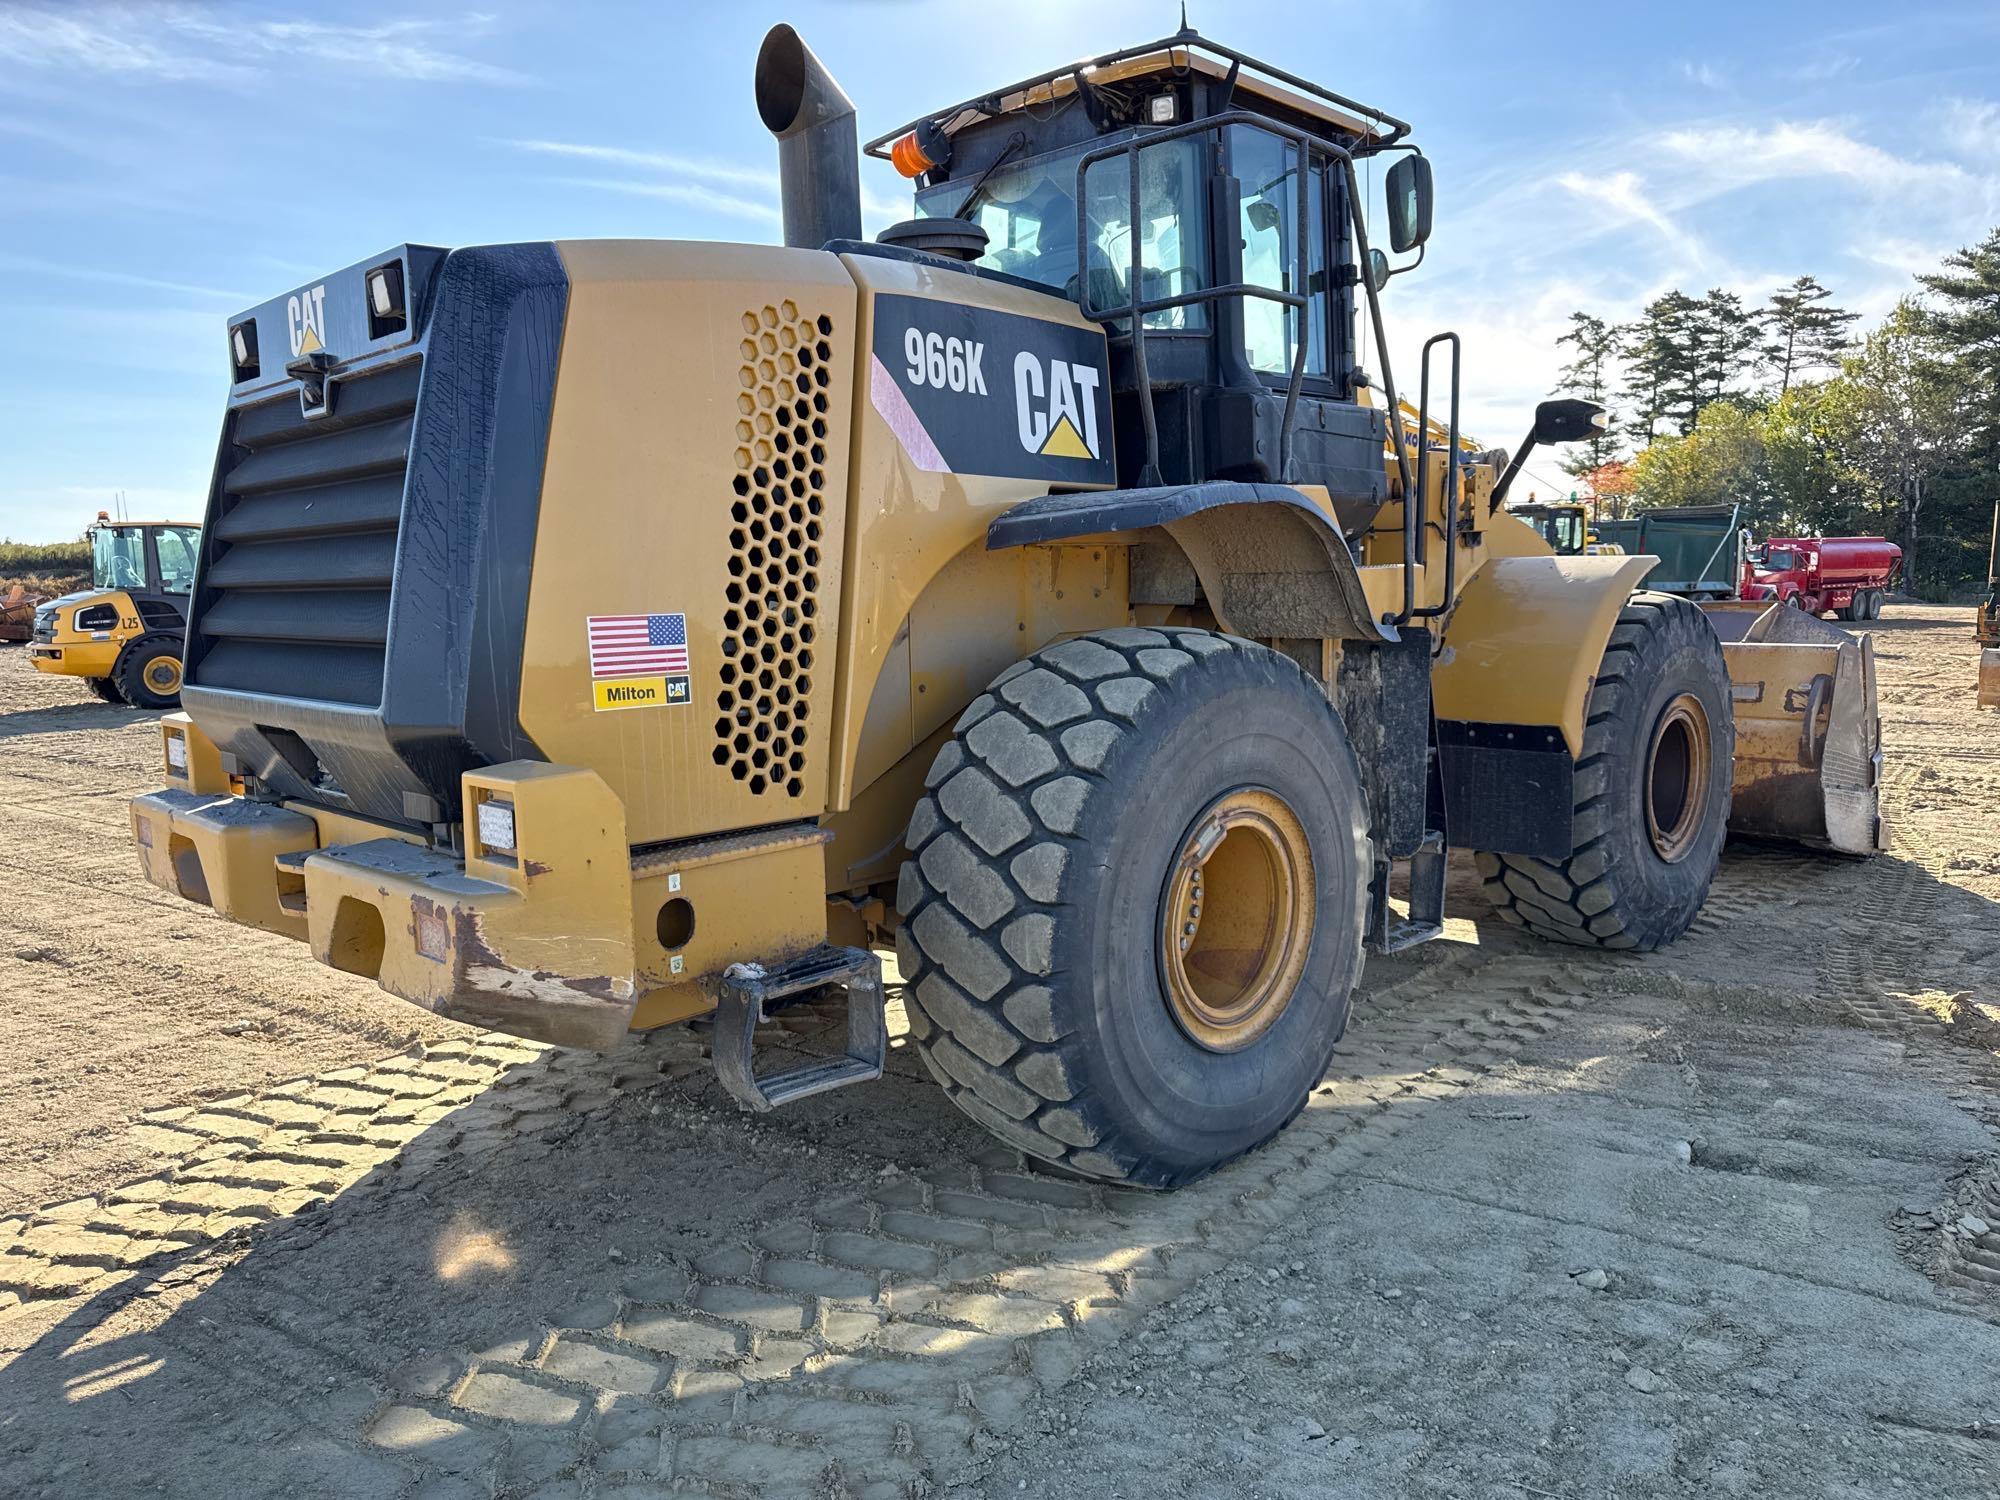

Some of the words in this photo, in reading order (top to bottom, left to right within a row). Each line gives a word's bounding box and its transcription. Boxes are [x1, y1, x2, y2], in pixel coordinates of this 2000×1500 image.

[287, 285, 326, 357] CAT
[904, 327, 988, 396] 966K
[1013, 351, 1100, 460] CAT
[121, 617, 139, 630] L25
[606, 687, 656, 702] Milton
[667, 682, 687, 698] CAT
